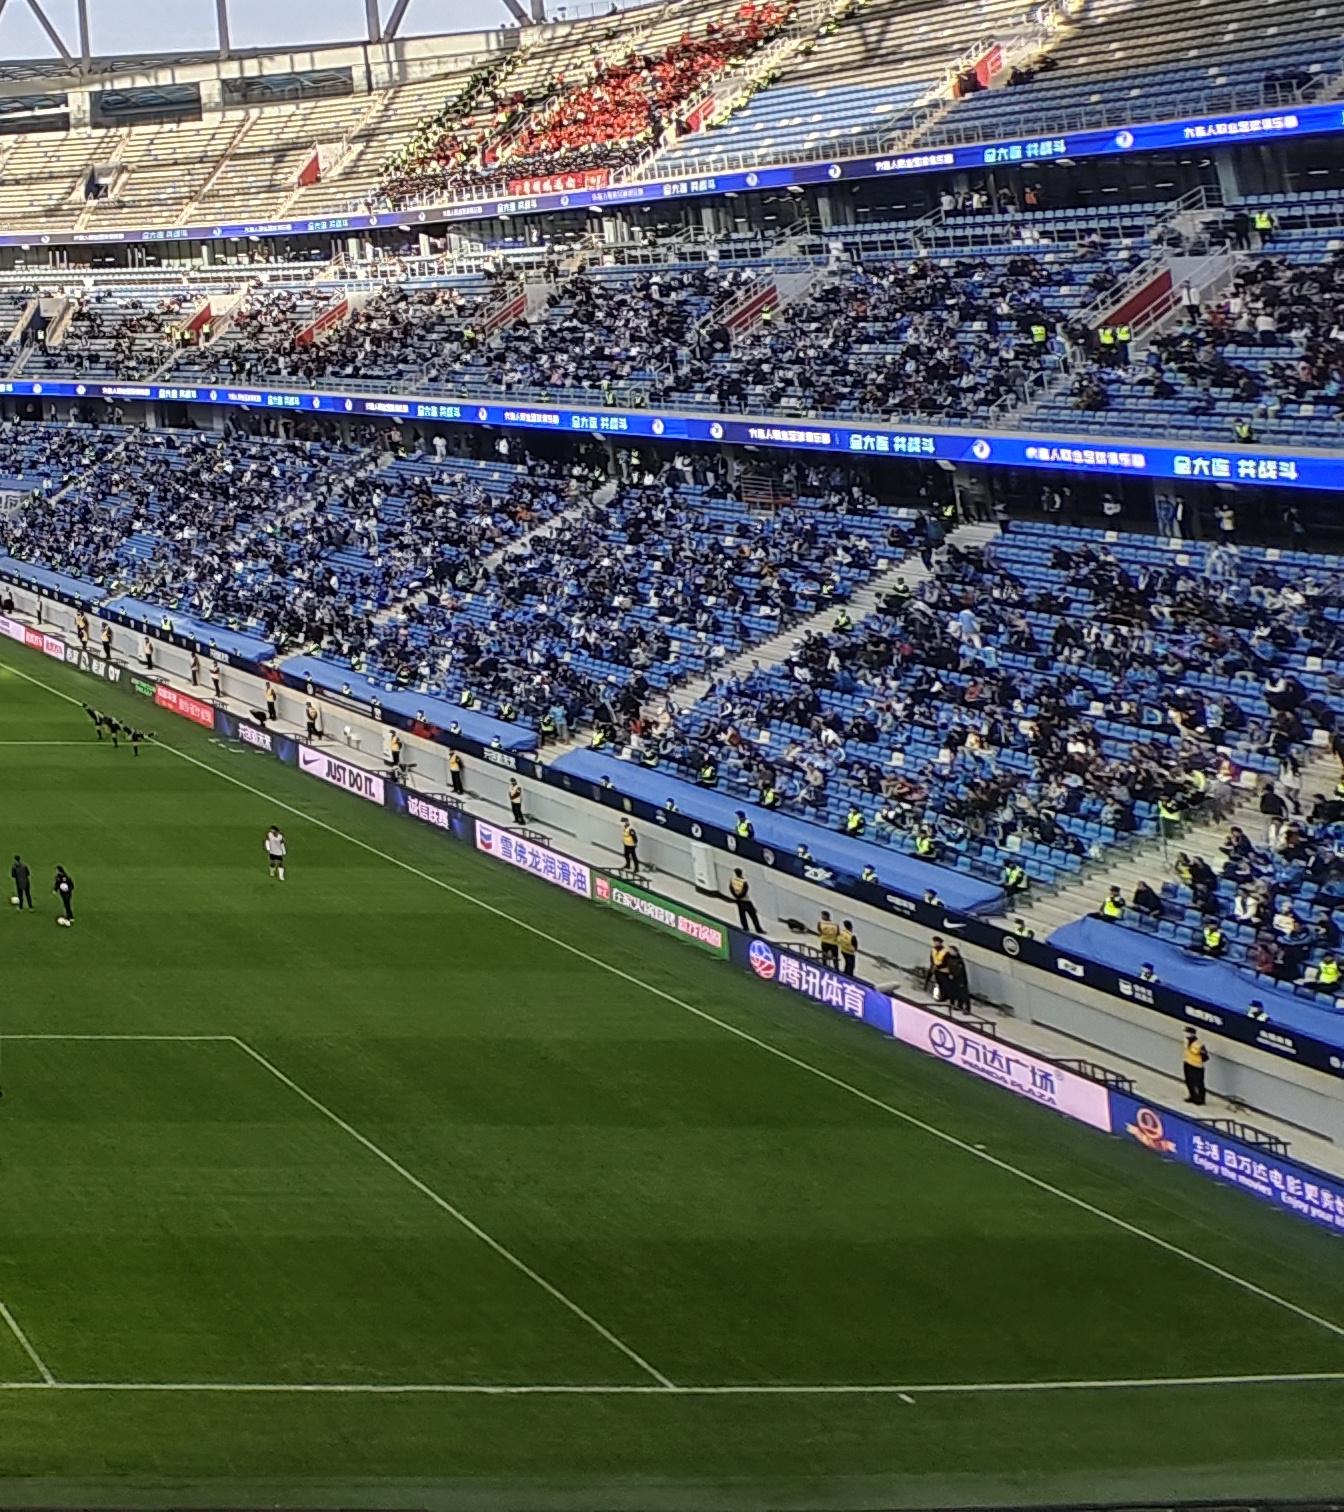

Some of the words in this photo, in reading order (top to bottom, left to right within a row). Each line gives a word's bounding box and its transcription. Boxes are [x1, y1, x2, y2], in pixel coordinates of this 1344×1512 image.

[326, 759, 347, 787] JUST
[348, 769, 363, 792] DO
[364, 775, 376, 798] IT.
[500, 834, 587, 893] 雪佛龙润滑油
[779, 954, 865, 1018] 腾讯体育
[958, 1034, 1056, 1095] 万达广场
[1010, 1079, 1058, 1106] PLAZA
[1192, 1135, 1220, 1162] 生活
[1193, 1153, 1219, 1175] Enjoy
[1280, 1191, 1309, 1214] Enjoy
